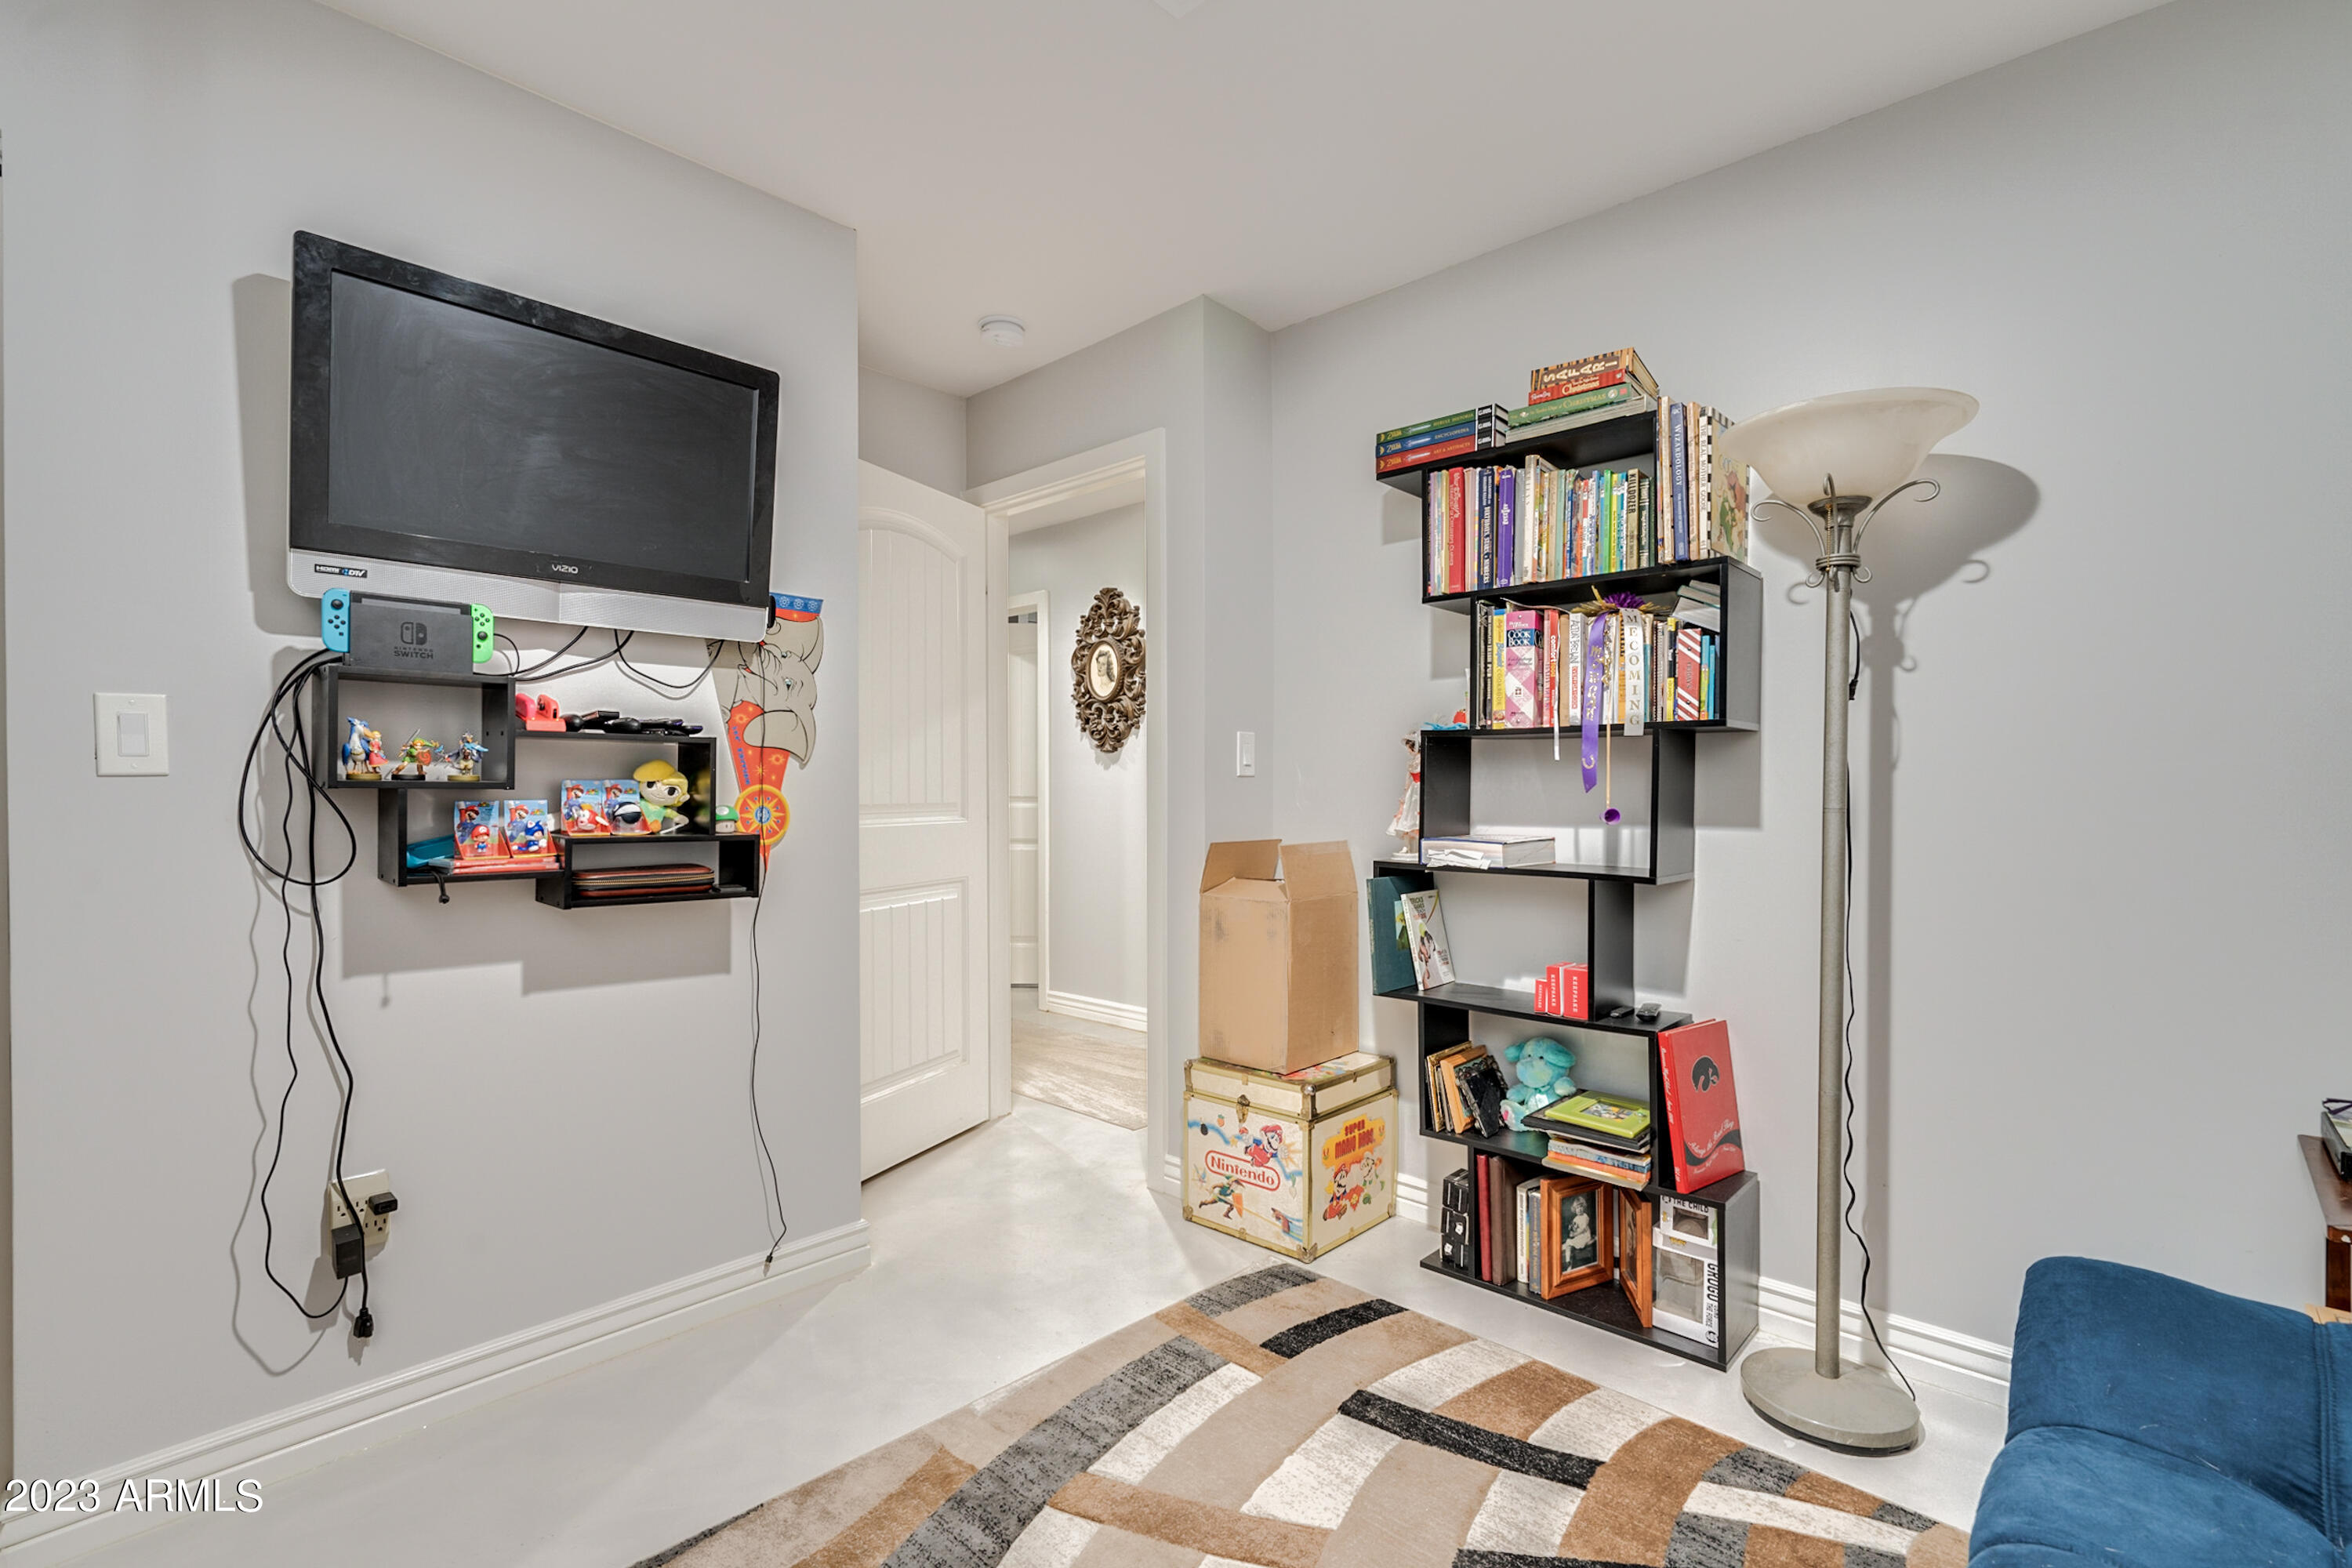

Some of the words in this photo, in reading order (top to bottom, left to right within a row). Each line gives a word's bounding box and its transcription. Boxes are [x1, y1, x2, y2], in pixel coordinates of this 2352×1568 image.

[1544, 361, 1617, 383] SAFARI
[552, 564, 579, 574] VIZIO
[394, 650, 434, 659] SWITCH
[1625, 609, 1641, 726] MECOMING
[1345, 1119, 1365, 1136] SUPER
[1334, 1134, 1356, 1160] MARIO
[1208, 1156, 1276, 1186] Nintendo
[1688, 1201, 1709, 1213] CHILD
